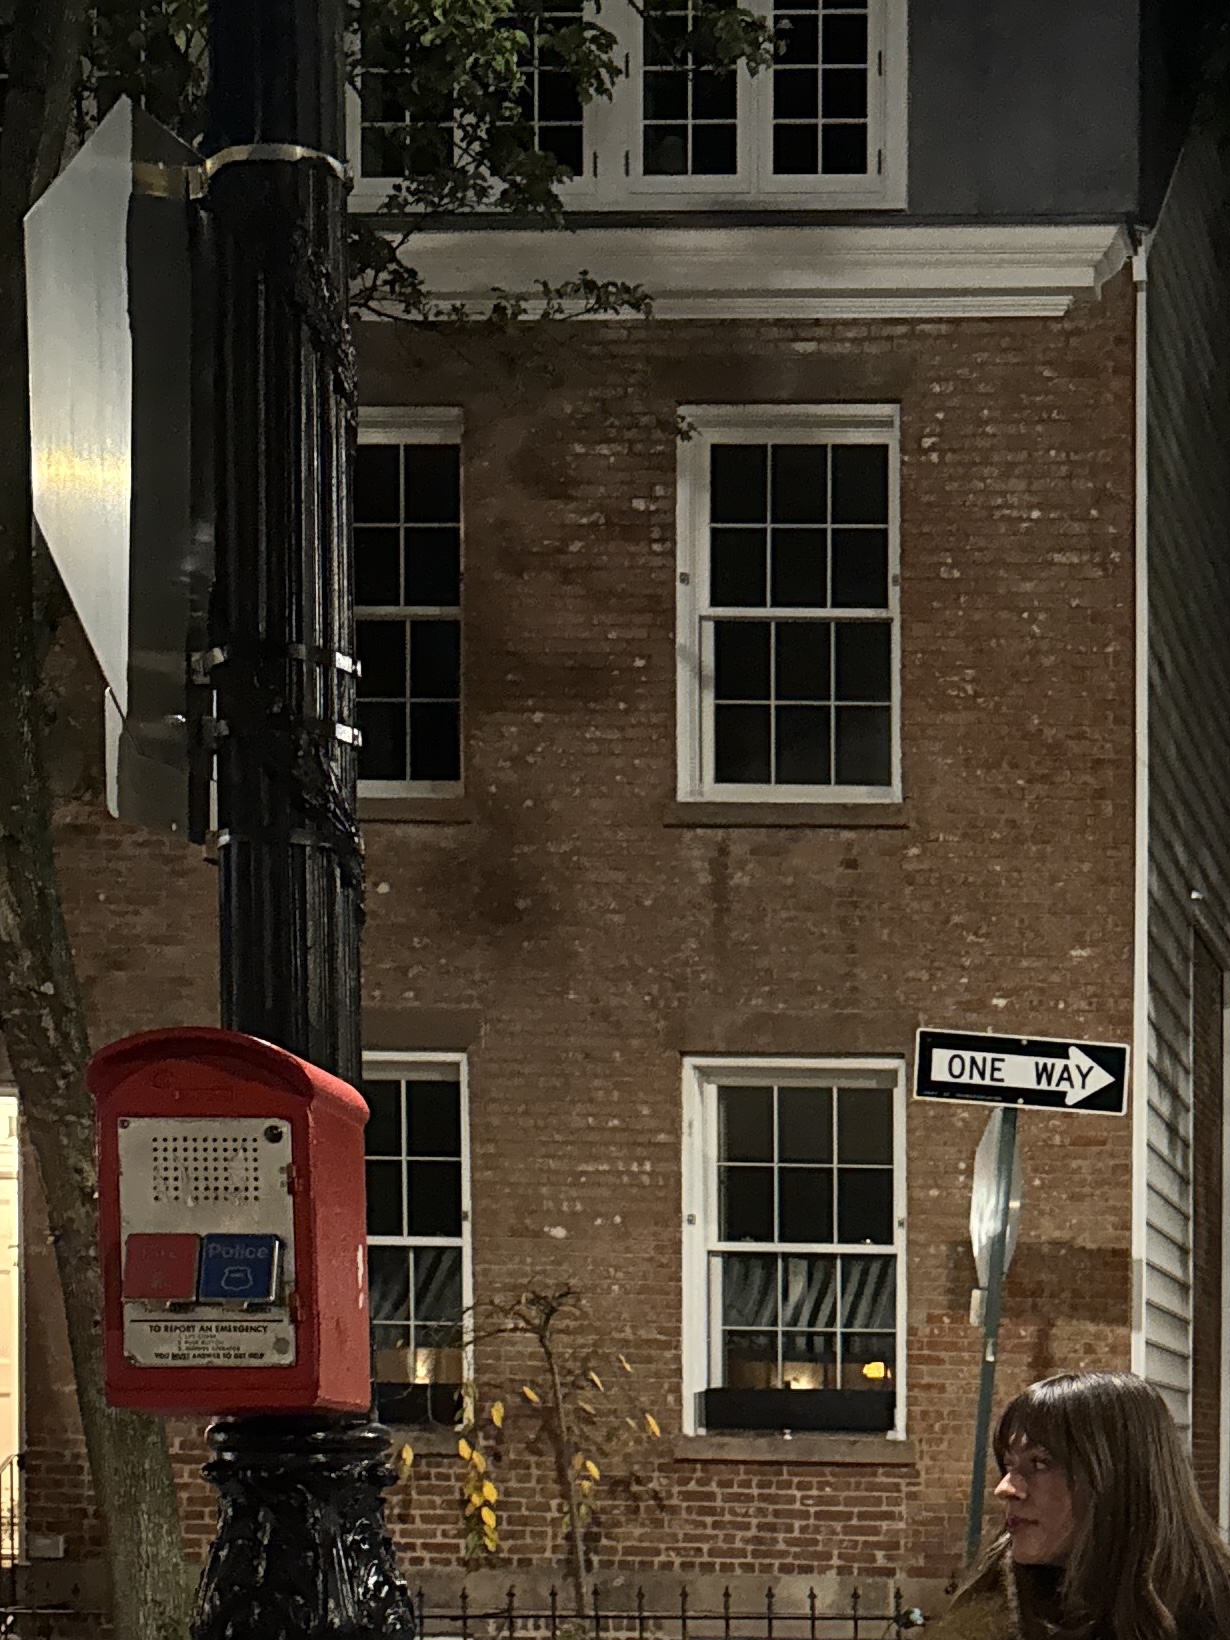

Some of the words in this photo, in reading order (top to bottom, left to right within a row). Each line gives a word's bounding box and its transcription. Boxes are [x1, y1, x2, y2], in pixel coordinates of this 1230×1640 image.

[948, 1054, 1005, 1082] ONE
[1035, 1061, 1094, 1089] WAY
[207, 1242, 269, 1259] Police
[149, 1325, 161, 1333] TO
[163, 1325, 196, 1333] REPORT
[199, 1325, 212, 1333] AN
[215, 1325, 268, 1334] EMERGENCY
